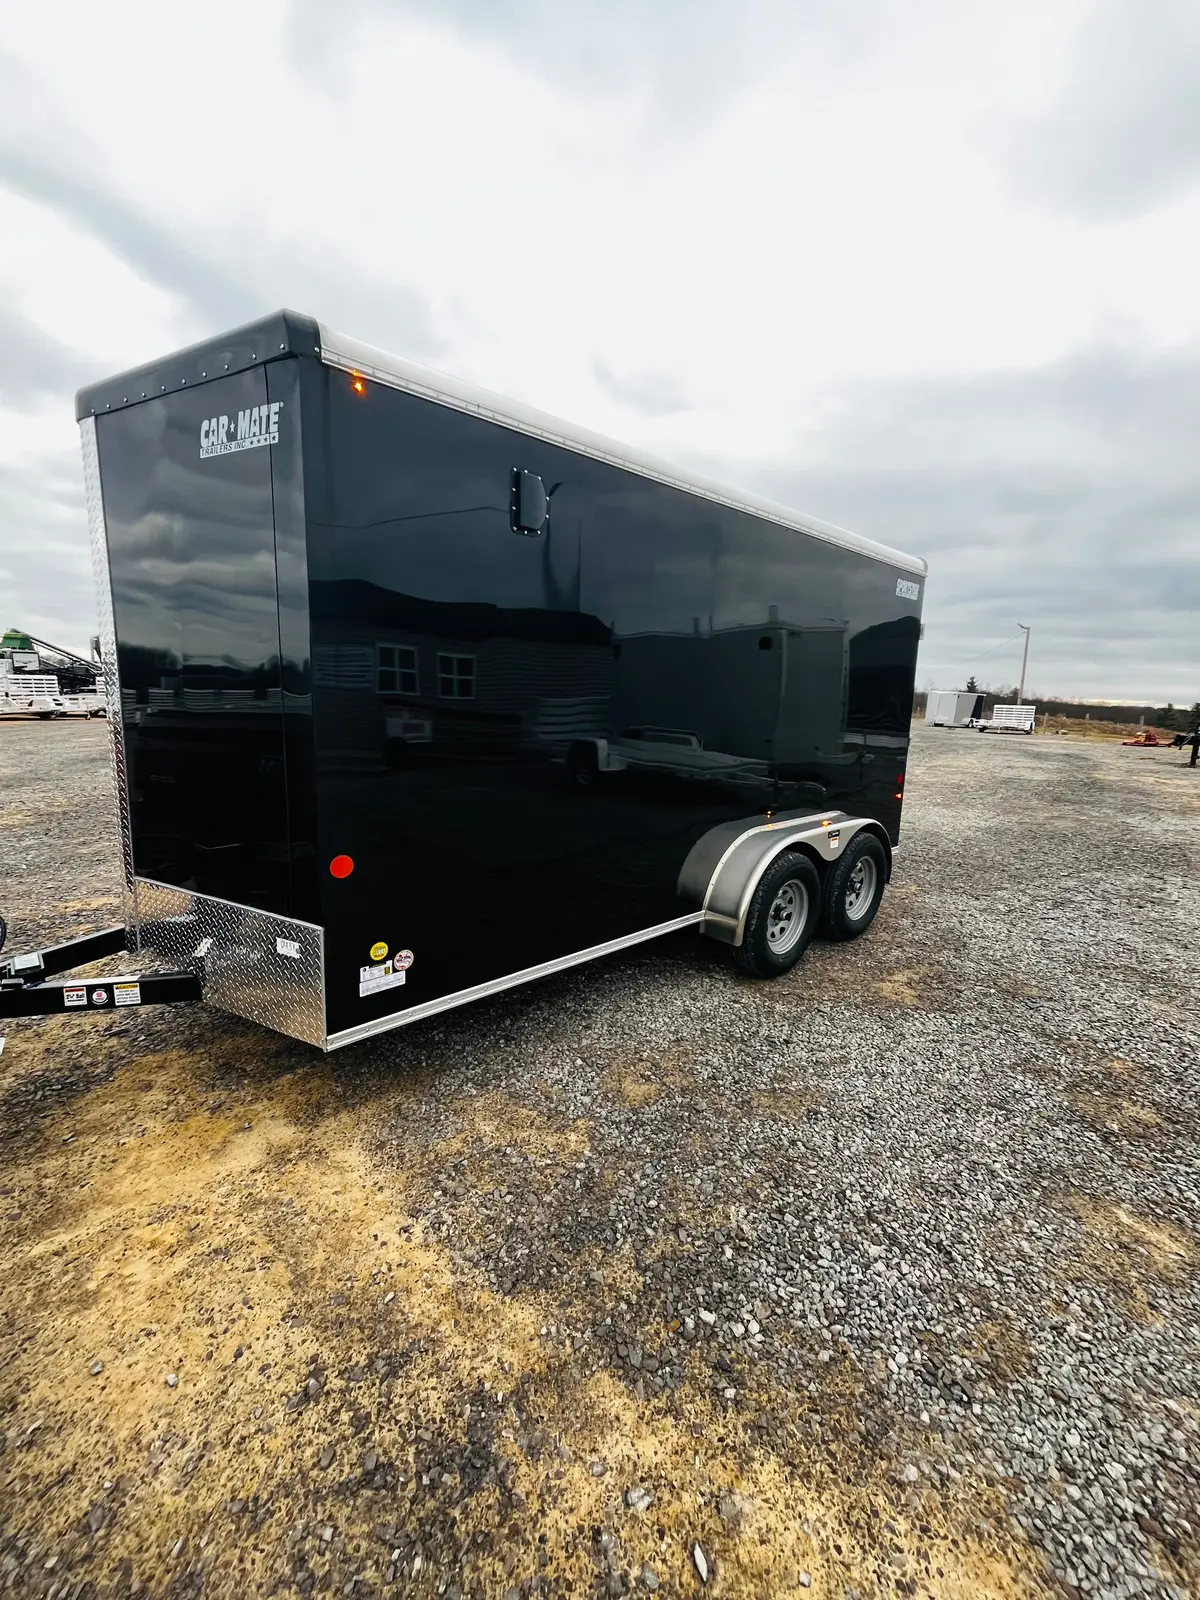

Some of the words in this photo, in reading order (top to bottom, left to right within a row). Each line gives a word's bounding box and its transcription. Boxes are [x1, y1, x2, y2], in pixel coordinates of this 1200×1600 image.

[200, 415, 228, 448] CAR
[237, 402, 280, 440] MATE
[201, 443, 233, 457] TRAILERS
